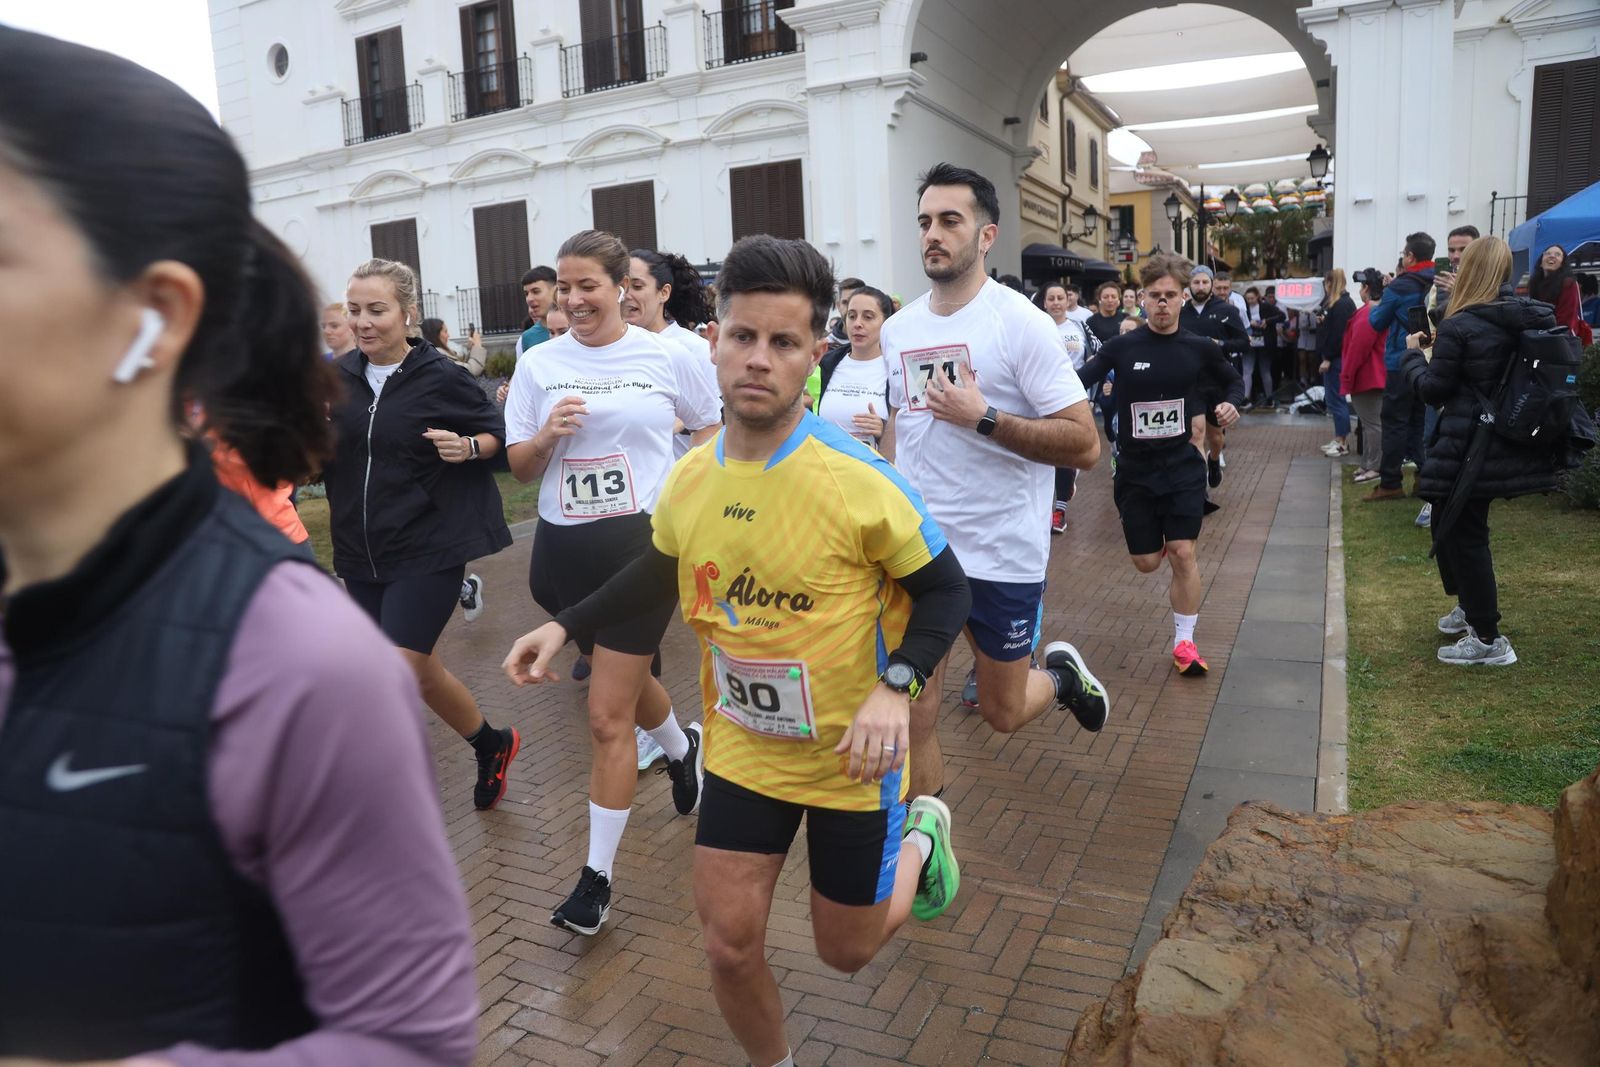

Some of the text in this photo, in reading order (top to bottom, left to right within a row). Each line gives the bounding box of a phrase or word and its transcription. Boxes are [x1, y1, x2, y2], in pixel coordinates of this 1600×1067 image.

[1133, 362, 1151, 371] SP
[558, 382, 611, 391] Internacional
[632, 381, 653, 390] Mujer
[1139, 409, 1179, 426] 144
[565, 470, 626, 498] 113
[726, 566, 814, 612] Álora
[744, 616, 780, 630] Málaga
[726, 672, 781, 713] 90
